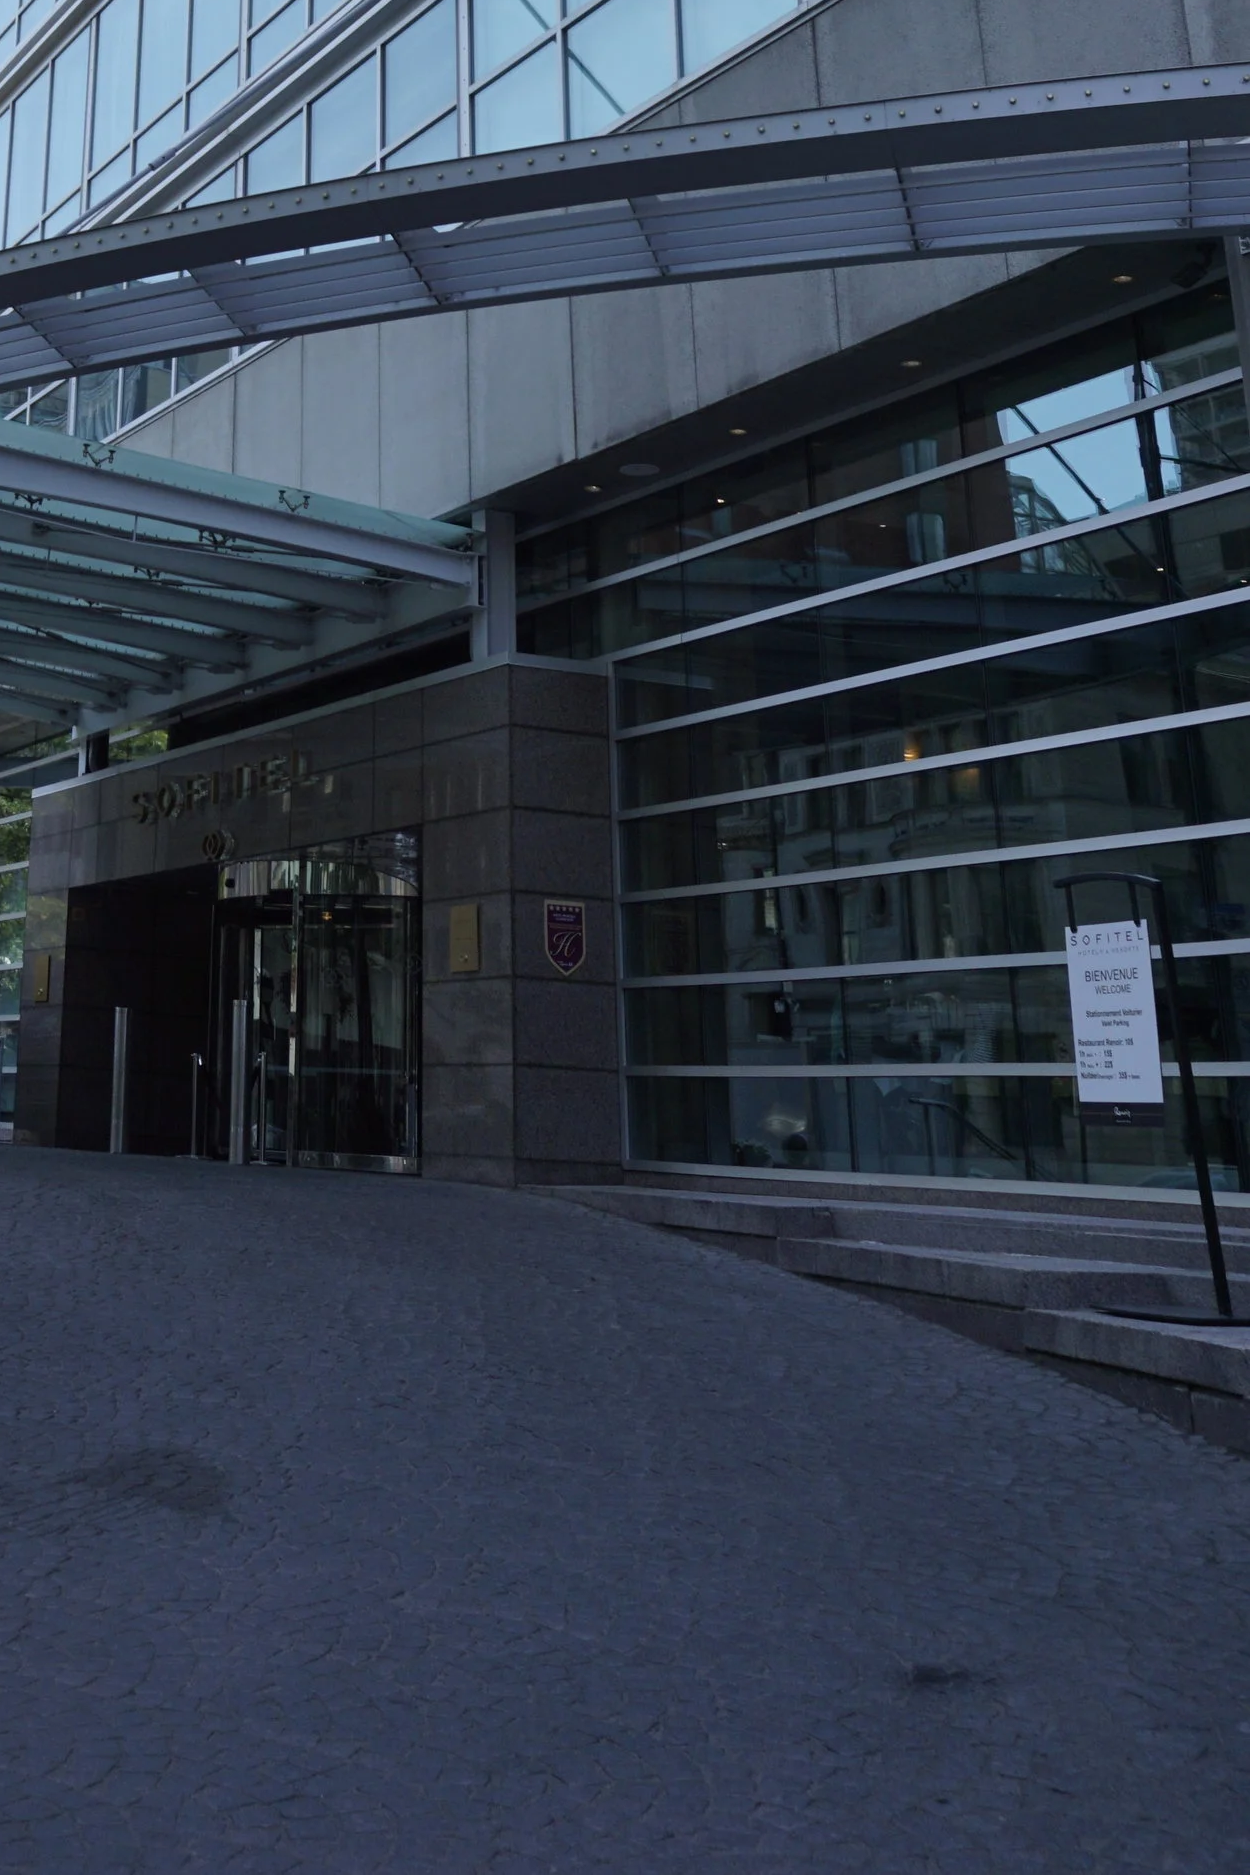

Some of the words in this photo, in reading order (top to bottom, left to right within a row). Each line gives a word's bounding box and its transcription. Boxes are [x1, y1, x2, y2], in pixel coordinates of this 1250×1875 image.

[132, 747, 319, 824] SOFITEL
[1070, 930, 1144, 947] SOFITEL
[1084, 967, 1139, 982] BIENVENUE
[1095, 984, 1133, 995] WELCOME
